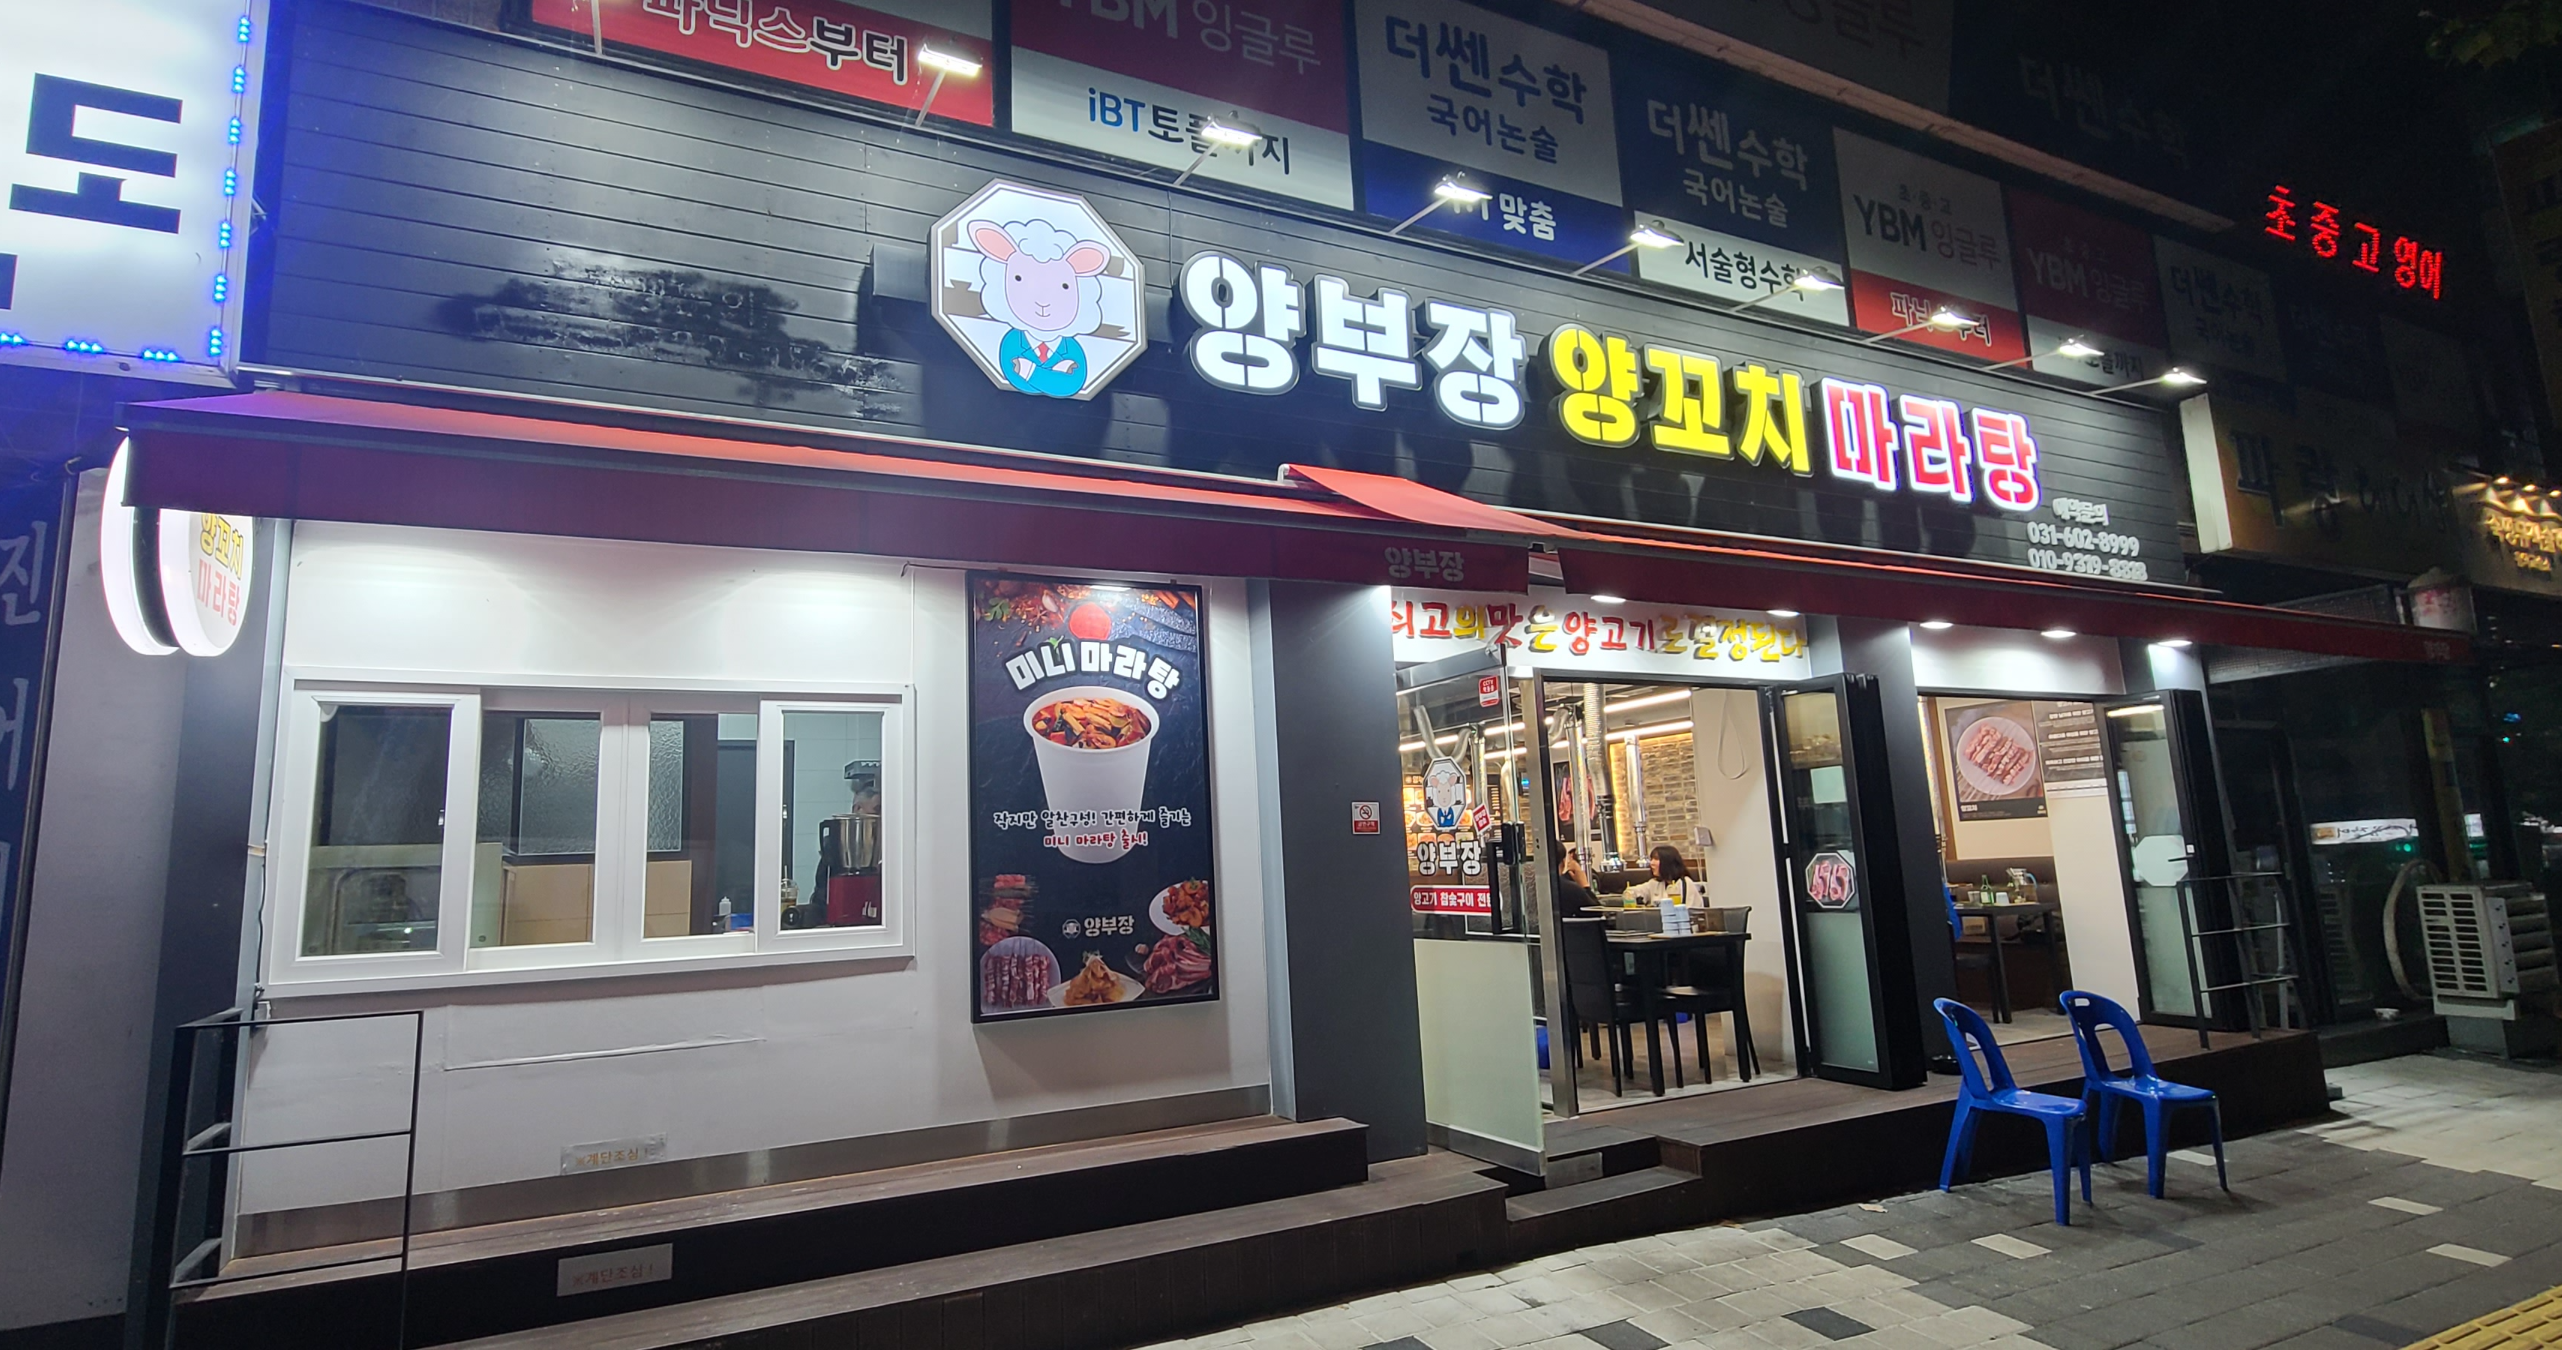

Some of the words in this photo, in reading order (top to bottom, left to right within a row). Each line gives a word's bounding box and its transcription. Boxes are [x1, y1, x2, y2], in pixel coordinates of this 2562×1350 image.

[1499, 192, 1557, 241] 맞춤
[1853, 194, 1927, 251] YBM
[2026, 247, 2089, 298] YBM
[1180, 250, 1526, 428] 양부장
[1549, 324, 1813, 475] 양꼬치
[1820, 378, 2039, 508] 마라탕
[2027, 521, 2140, 557] 031-602-8999
[1384, 546, 1465, 582] 양부장
[197, 558, 240, 626] 마라탕
[1006, 642, 1076, 690] 미니
[1080, 641, 1180, 700] 마라탕
[993, 811, 1037, 830] 작지만
[1100, 809, 1155, 827] 간편하게
[1158, 806, 1192, 827] 즐기는
[1043, 834, 1070, 848] 미니
[1075, 832, 1116, 849] 마라탕
[1120, 829, 1149, 850] 출시!
[1416, 840, 1482, 876] 양부장
[1083, 915, 1135, 938] 양부장
